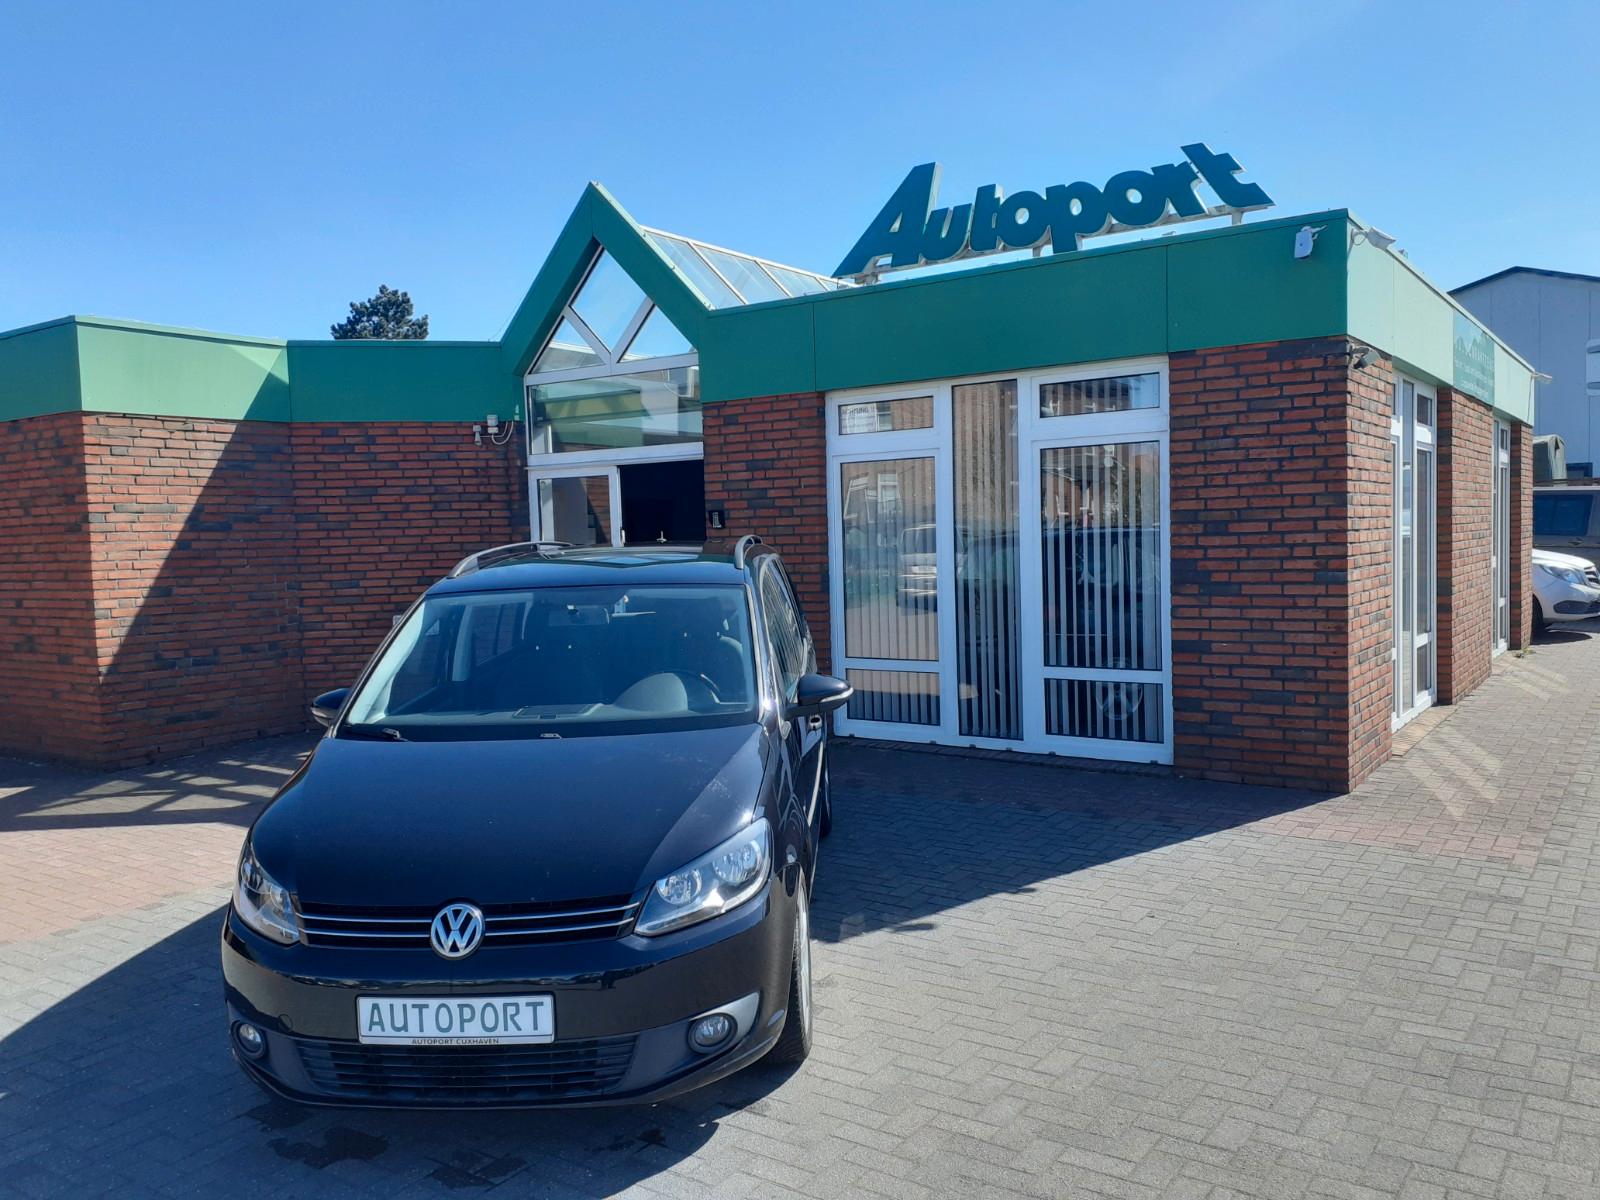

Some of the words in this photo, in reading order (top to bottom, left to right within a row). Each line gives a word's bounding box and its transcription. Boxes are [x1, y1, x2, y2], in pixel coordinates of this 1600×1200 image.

[831, 142, 1275, 278] Autoport
[431, 903, 482, 957] VW
[368, 1001, 544, 1034] AUTOPORT
